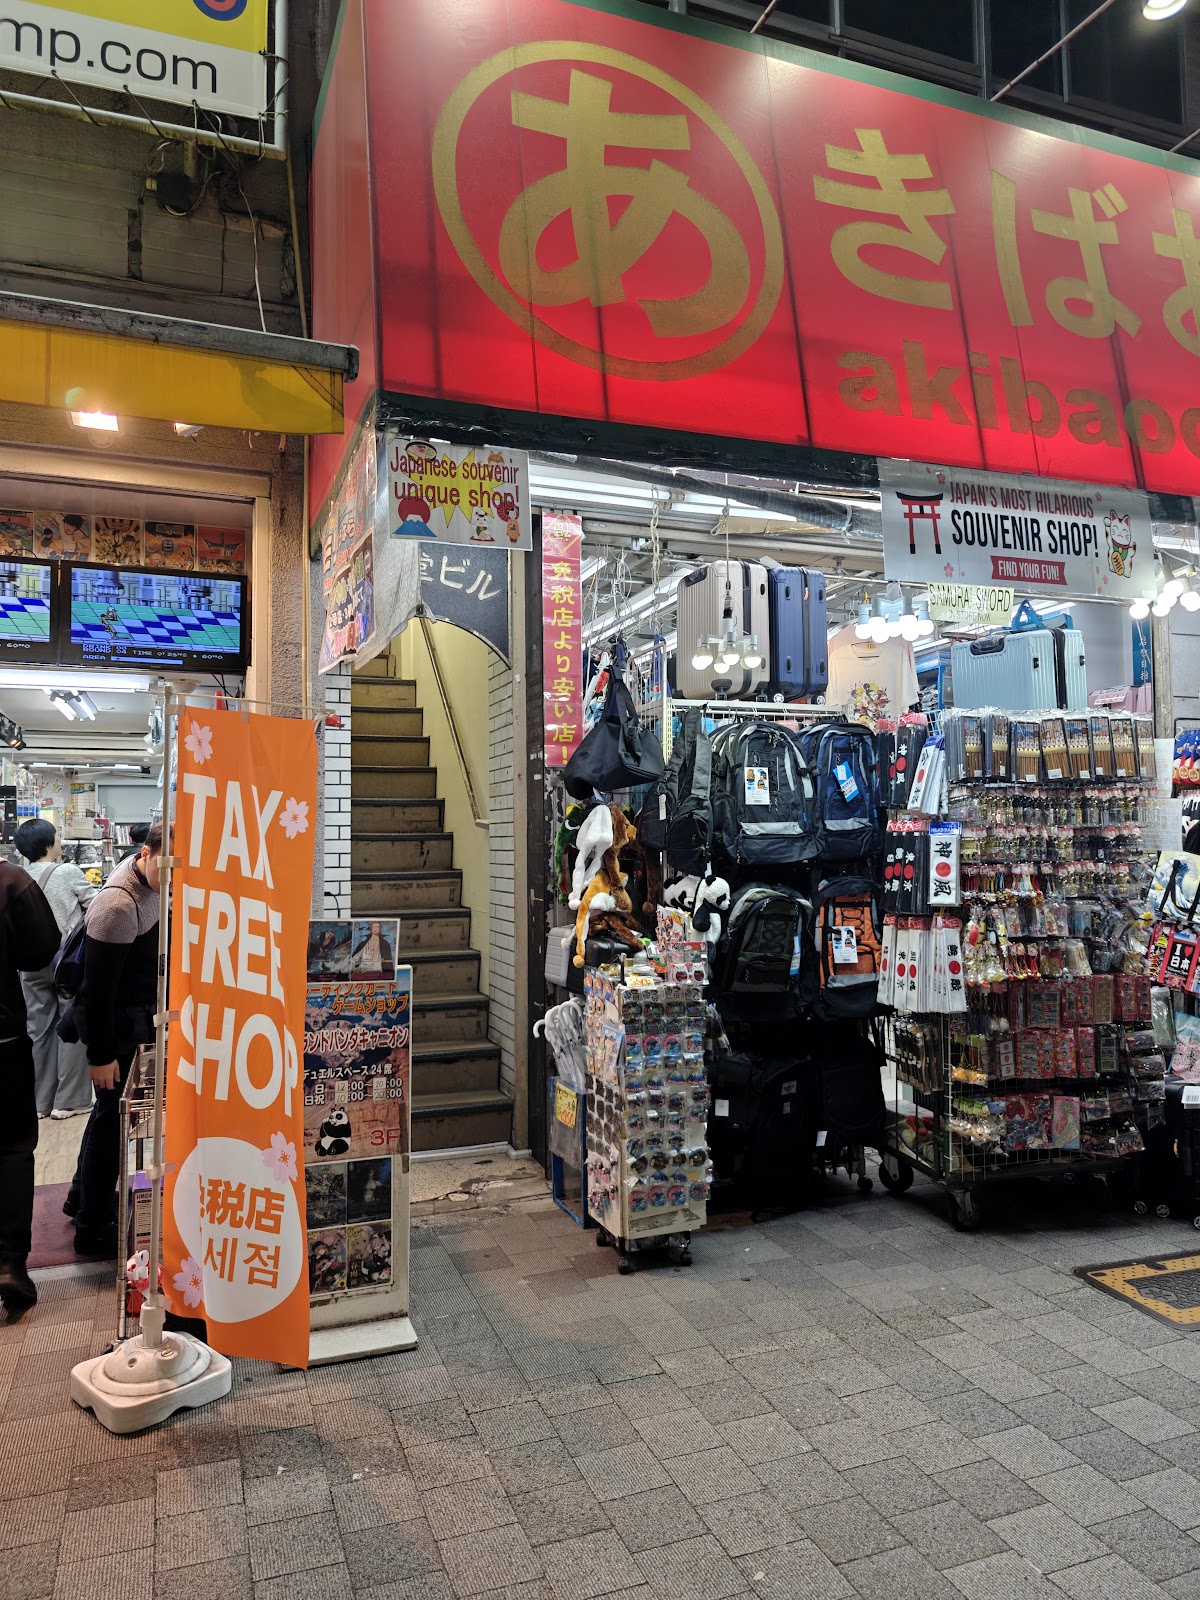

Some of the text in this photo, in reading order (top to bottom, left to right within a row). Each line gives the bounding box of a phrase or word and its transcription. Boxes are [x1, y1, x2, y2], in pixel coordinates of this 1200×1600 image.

[500, 68, 751, 338] あ
[390, 446, 519, 484] Japanese souvenir
[394, 475, 461, 508] unique
[468, 481, 519, 511] shop!
[1000, 487, 1032, 511] MOST
[1035, 491, 1095, 518] HILARIOUS
[951, 509, 1099, 558] SOUVENIR SHOP!
[998, 560, 1060, 581] FIND YOUR FUN!
[976, 586, 1011, 612] SWORD
[977, 612, 992, 621] NOW
[182, 772, 284, 890] TAX
[933, 840, 953, 898] 神風
[181, 882, 286, 1008] FREE
[1170, 955, 1191, 971] 日本
[332, 994, 408, 1015] ゲームショップ
[176, 993, 299, 1118] SHOP
[370, 1127, 401, 1146] 3F
[199, 1173, 285, 1235] 税店
[202, 1237, 281, 1289] 세점
